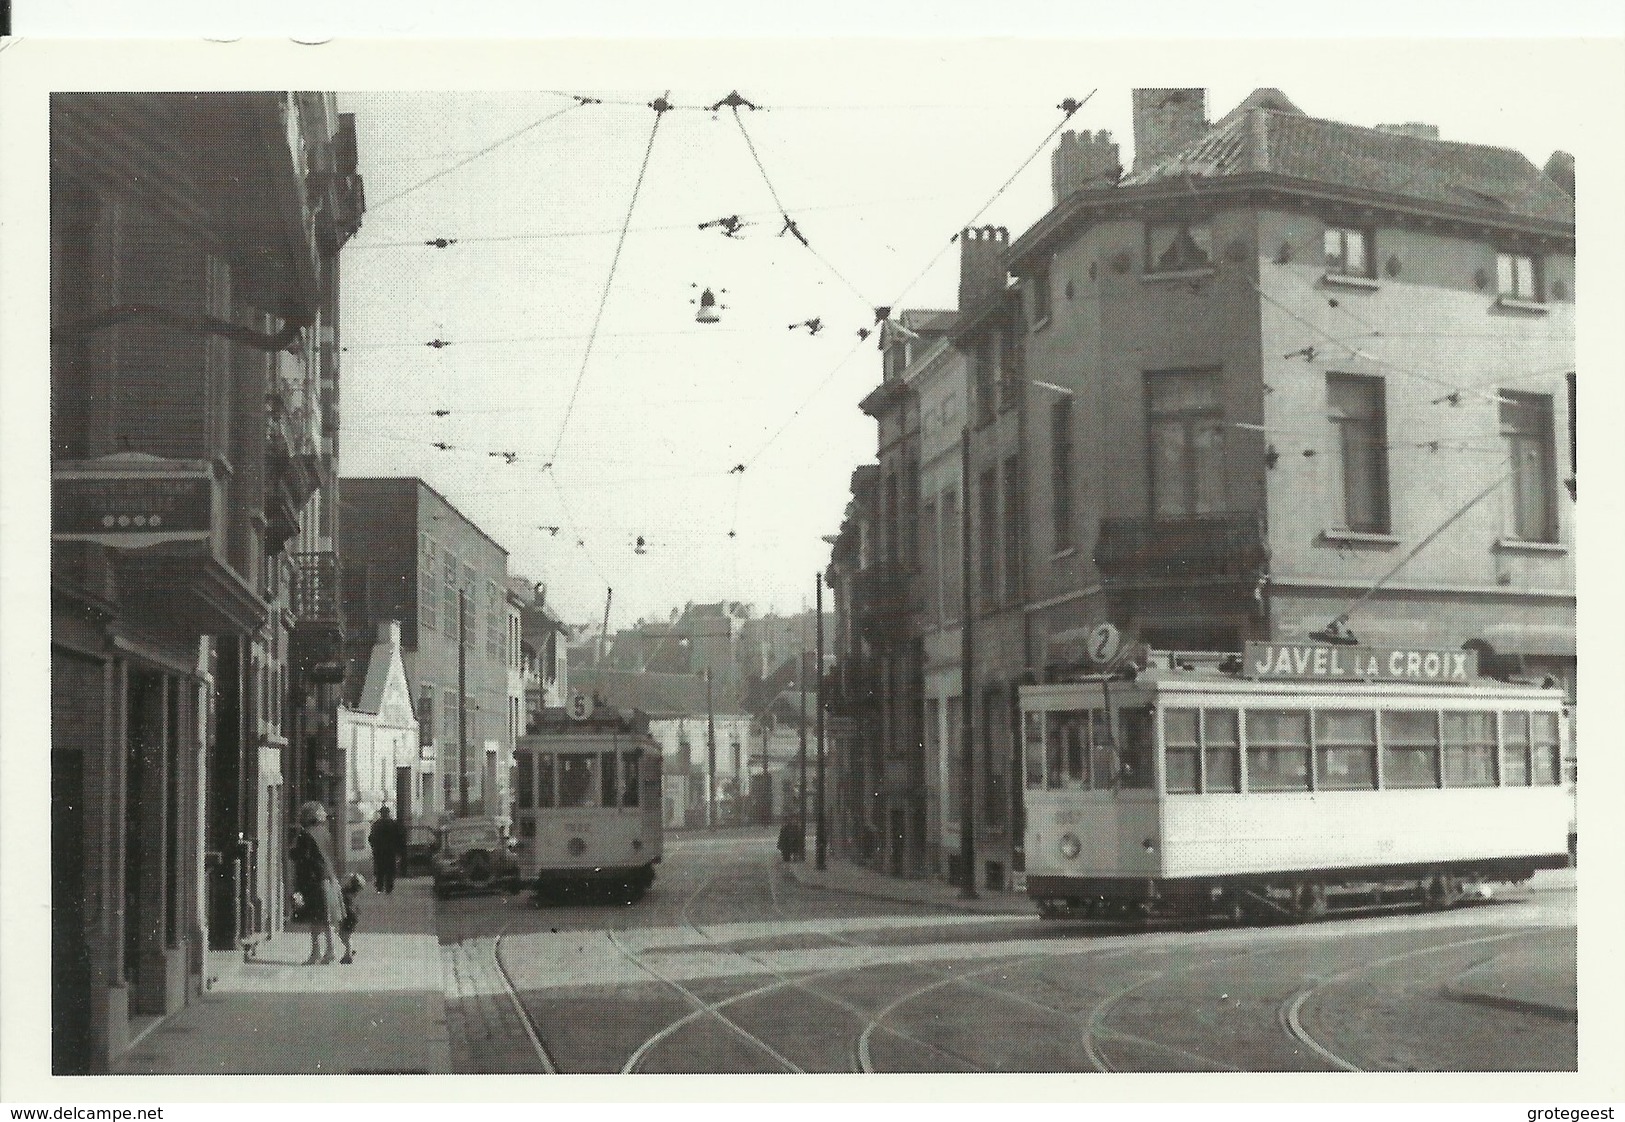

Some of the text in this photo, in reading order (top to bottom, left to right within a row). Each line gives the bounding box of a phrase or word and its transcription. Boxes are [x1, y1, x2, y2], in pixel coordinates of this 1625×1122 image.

[1096, 628, 1110, 659] 2
[1255, 647, 1468, 680] JAVEL LA CROIX
